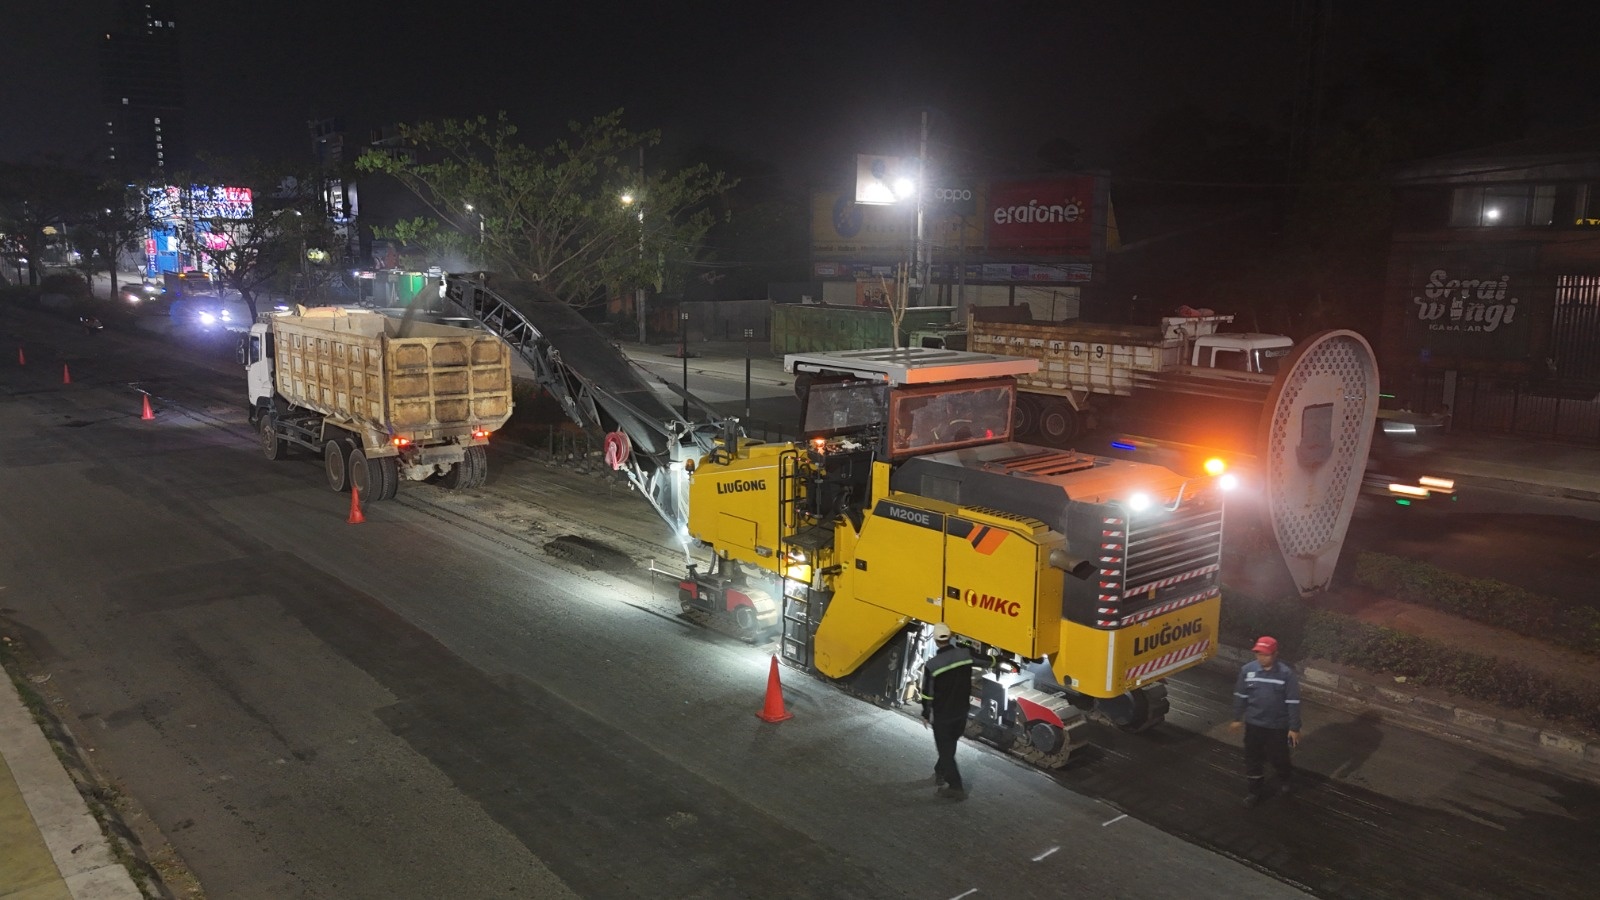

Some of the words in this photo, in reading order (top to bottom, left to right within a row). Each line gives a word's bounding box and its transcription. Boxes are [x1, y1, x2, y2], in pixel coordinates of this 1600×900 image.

[934, 188, 972, 203] oppo
[993, 199, 1080, 224] erafone
[716, 479, 766, 494] LIUGONG
[889, 506, 930, 525] M200E
[979, 593, 1021, 617] MKC
